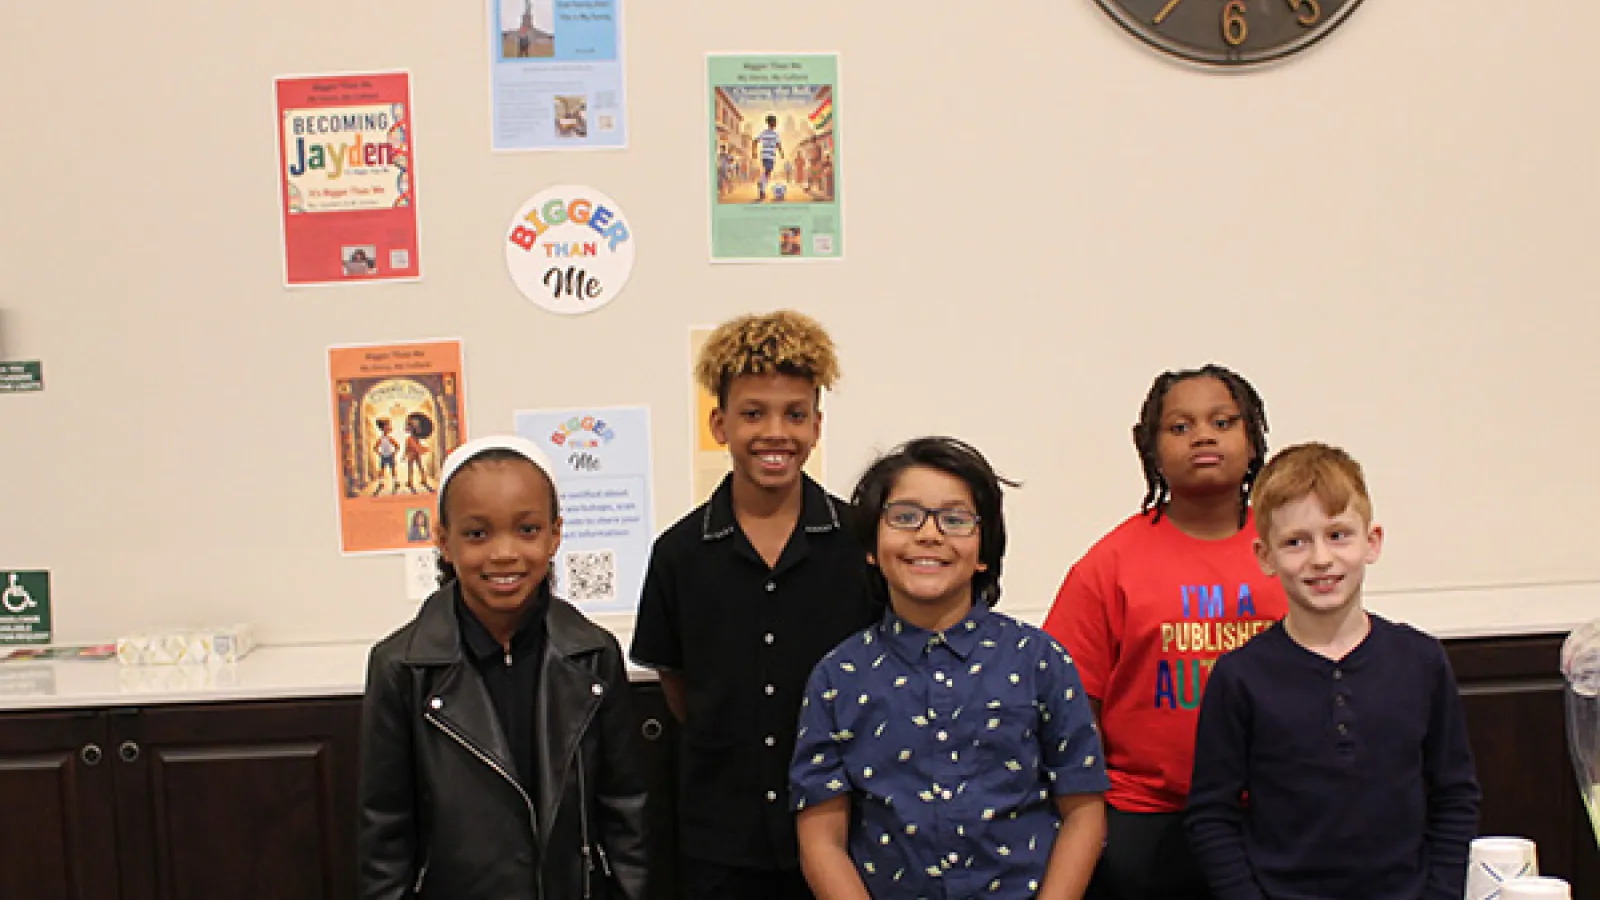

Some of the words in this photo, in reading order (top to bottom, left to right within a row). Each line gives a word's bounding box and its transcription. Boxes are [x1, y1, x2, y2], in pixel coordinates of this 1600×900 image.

[1223, 0, 1247, 45] 6
[293, 112, 388, 135] BECOMING
[289, 133, 393, 180] Jayden
[509, 198, 629, 252] BIGGER
[543, 242, 597, 258] THAN
[543, 266, 603, 301] Me
[550, 416, 615, 447] BIGGER
[568, 440, 598, 448] THAN
[567, 451, 602, 471] Me
[1180, 584, 1224, 618] I'M
[1237, 583, 1256, 616] A
